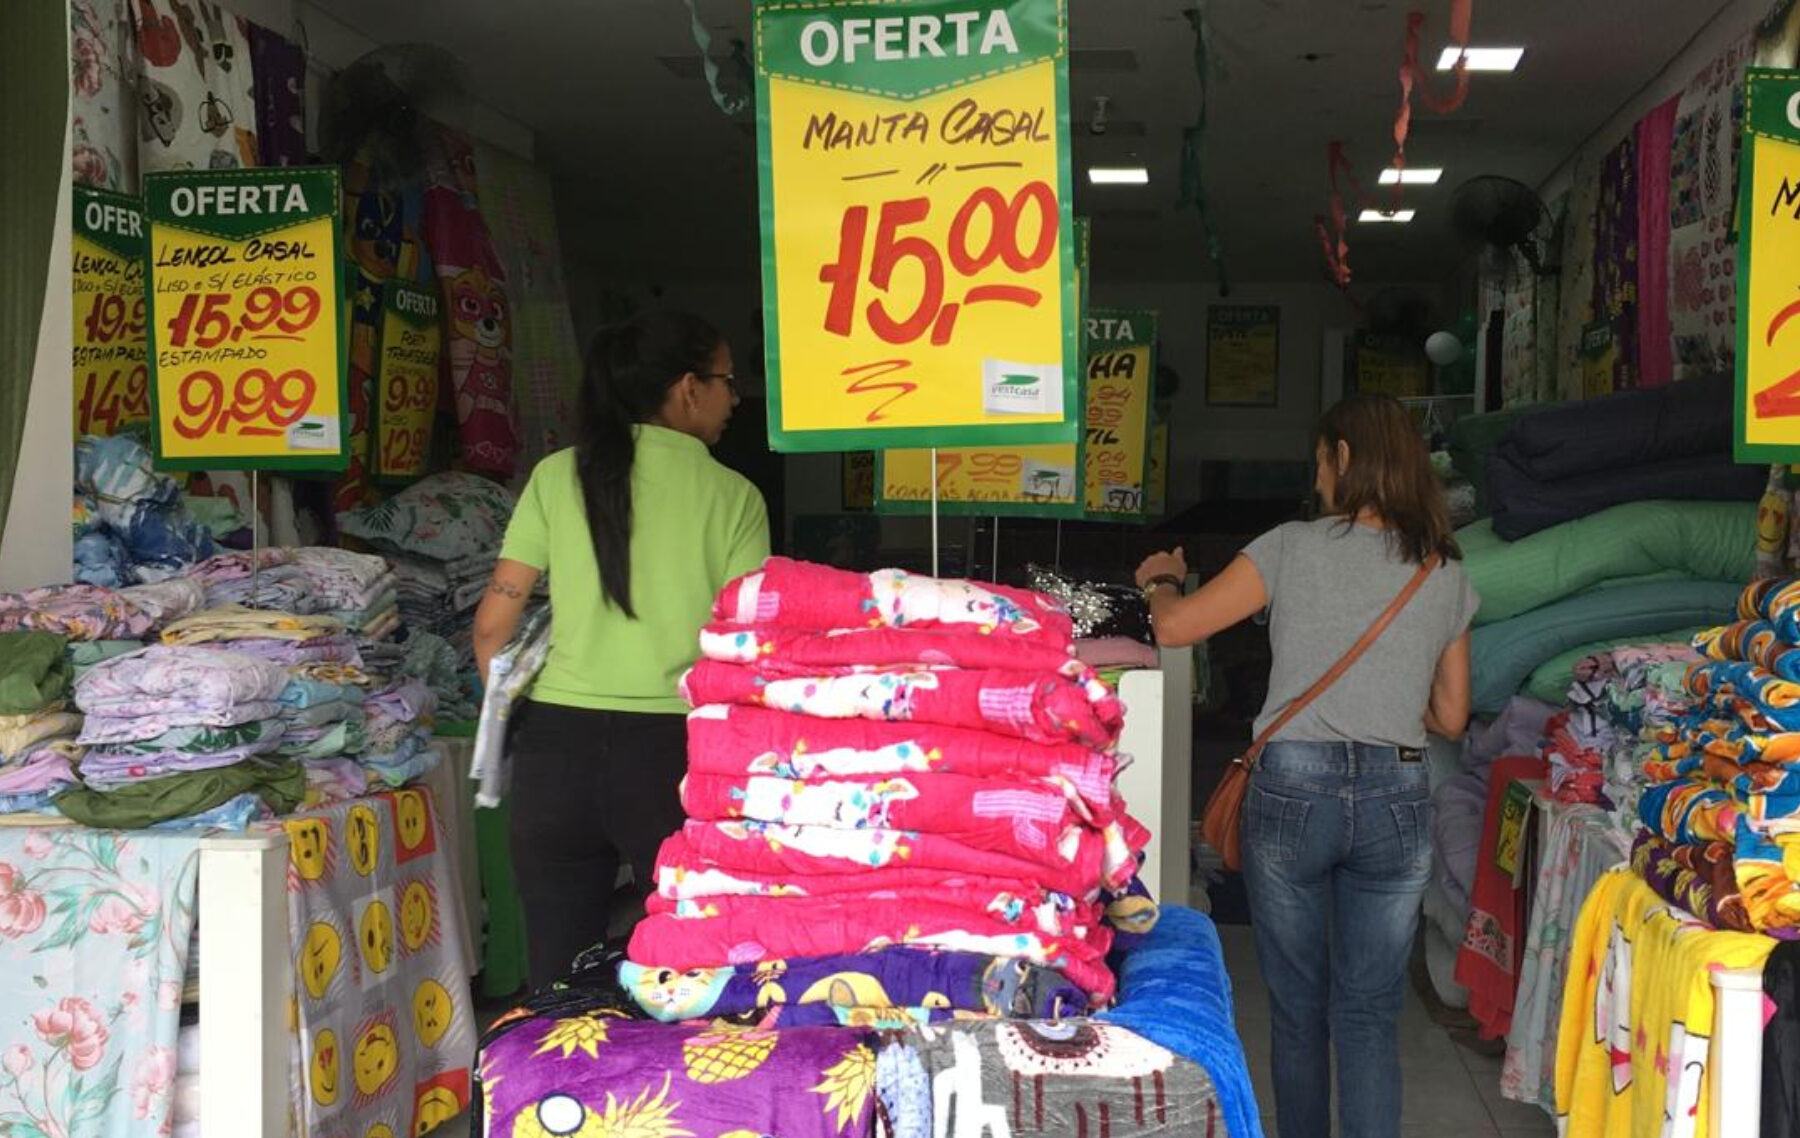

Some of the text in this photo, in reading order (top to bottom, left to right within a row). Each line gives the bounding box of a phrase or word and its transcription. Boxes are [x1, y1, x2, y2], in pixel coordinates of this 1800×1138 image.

[800, 9, 1019, 66] OFERTA
[803, 99, 1050, 151] MANTA CASAL
[170, 183, 309, 217] OFERTA
[85, 202, 144, 239] OFER
[243, 239, 316, 262] CASAL
[396, 288, 438, 318] OFERTA
[1086, 317, 1136, 342] RTA
[73, 345, 147, 367] ESTAMPAD
[158, 346, 267, 368] ESTAMPADO
[1089, 353, 1137, 379] HA
[173, 368, 317, 440] 9,99
